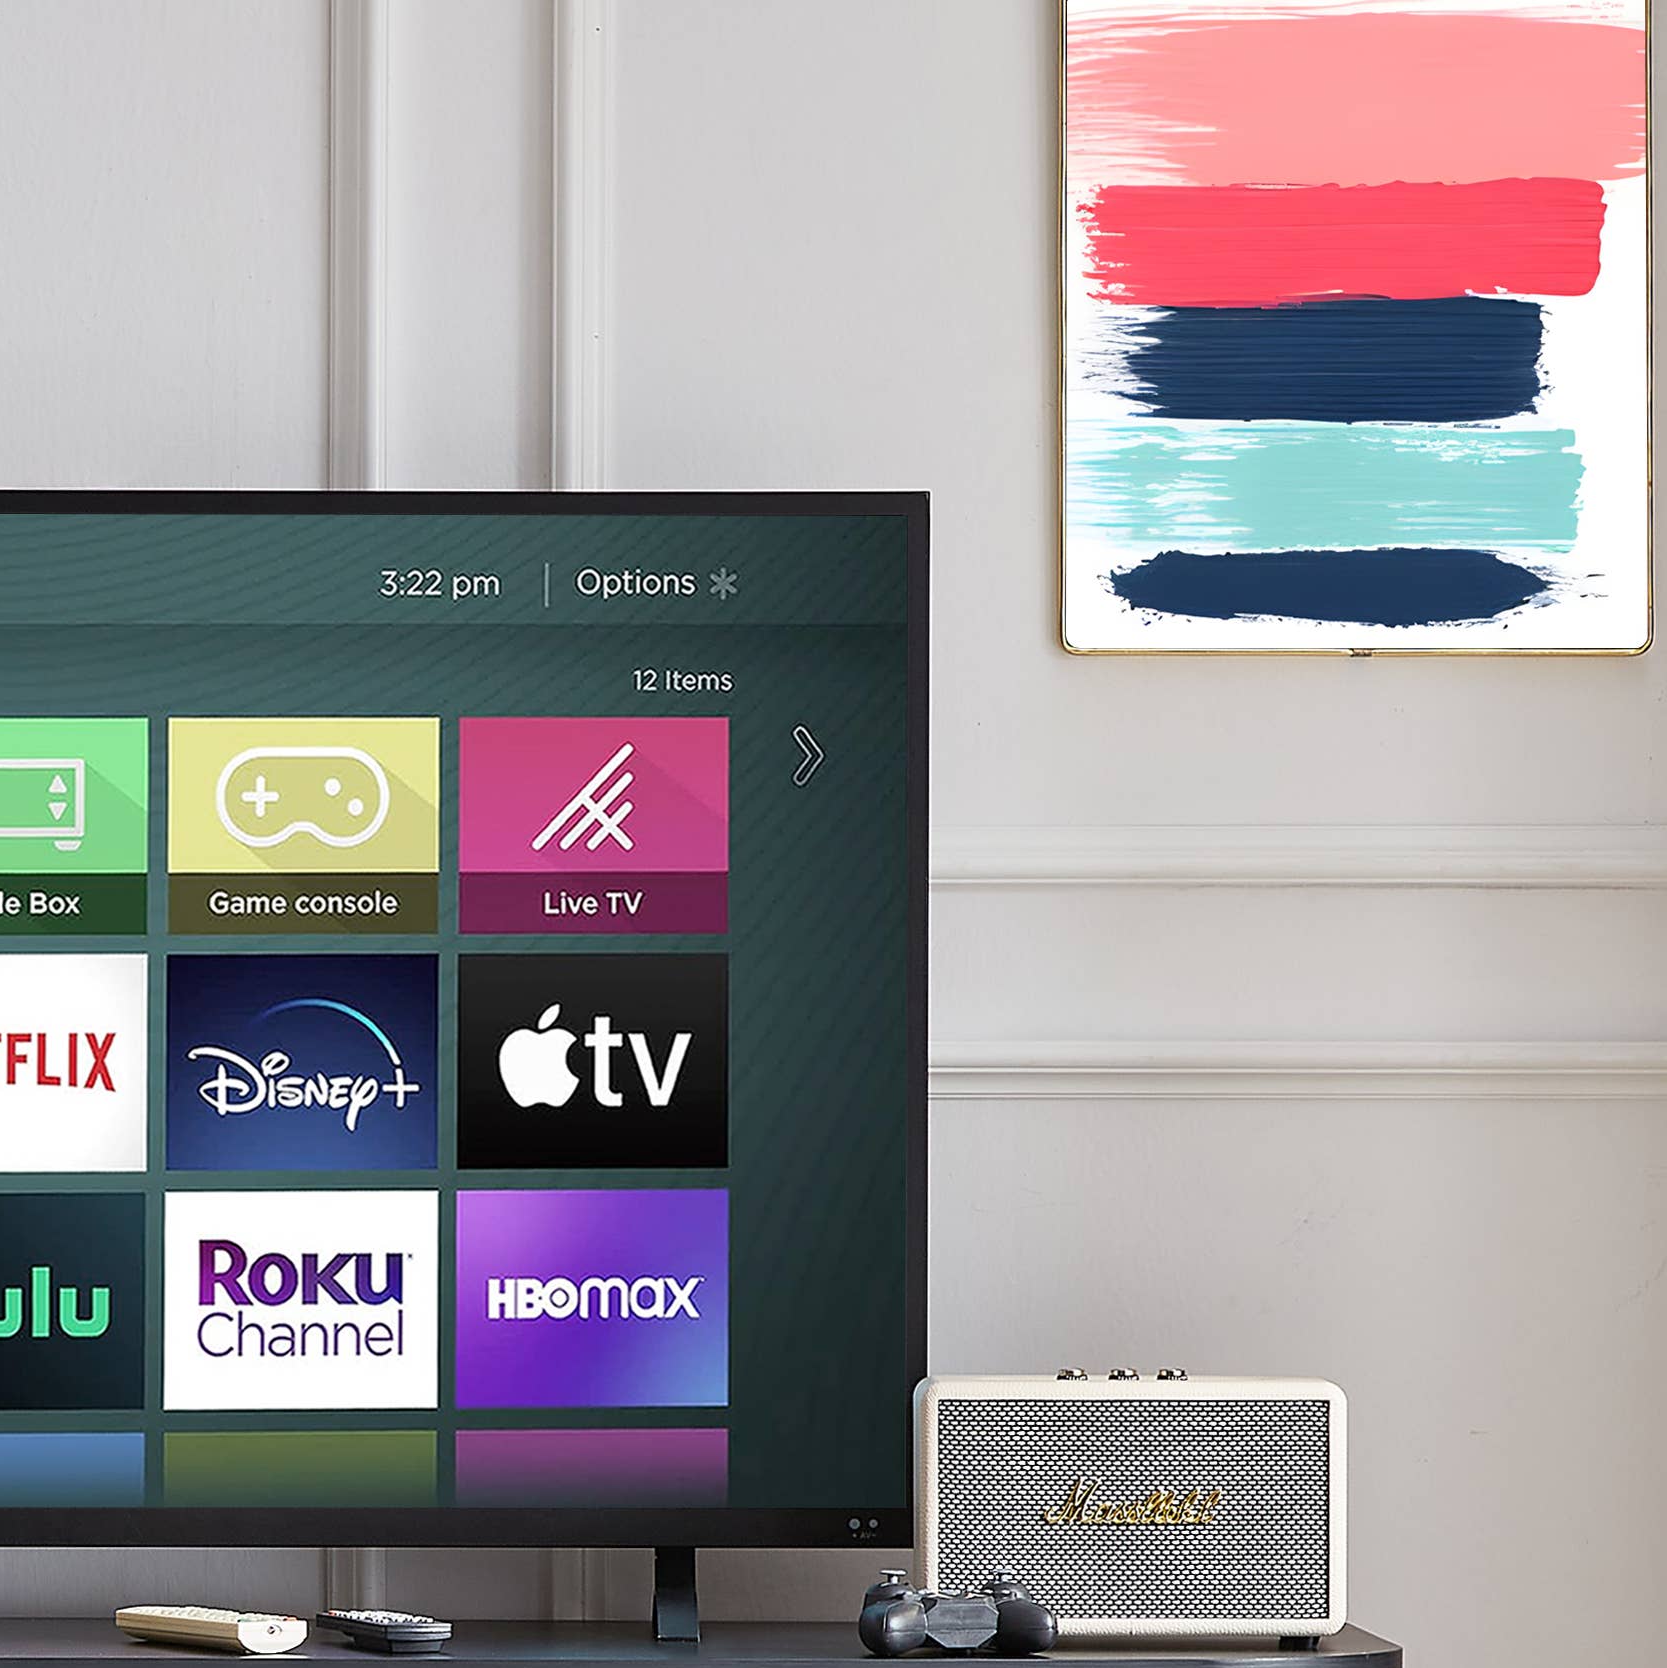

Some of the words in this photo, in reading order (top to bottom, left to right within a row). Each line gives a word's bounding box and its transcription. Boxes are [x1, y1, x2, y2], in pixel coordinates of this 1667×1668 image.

[381, 569, 441, 597] 3:22
[453, 574, 499, 599] pm
[578, 569, 695, 598] Options
[634, 670, 656, 690] 12
[667, 671, 732, 690] Items
[30, 893, 79, 914] Box
[209, 891, 287, 915] Game
[293, 891, 397, 915] console
[545, 892, 598, 914] Live
[606, 892, 642, 913] TV
[585, 1017, 691, 1106] tv
[198, 1310, 403, 1357] Channel
